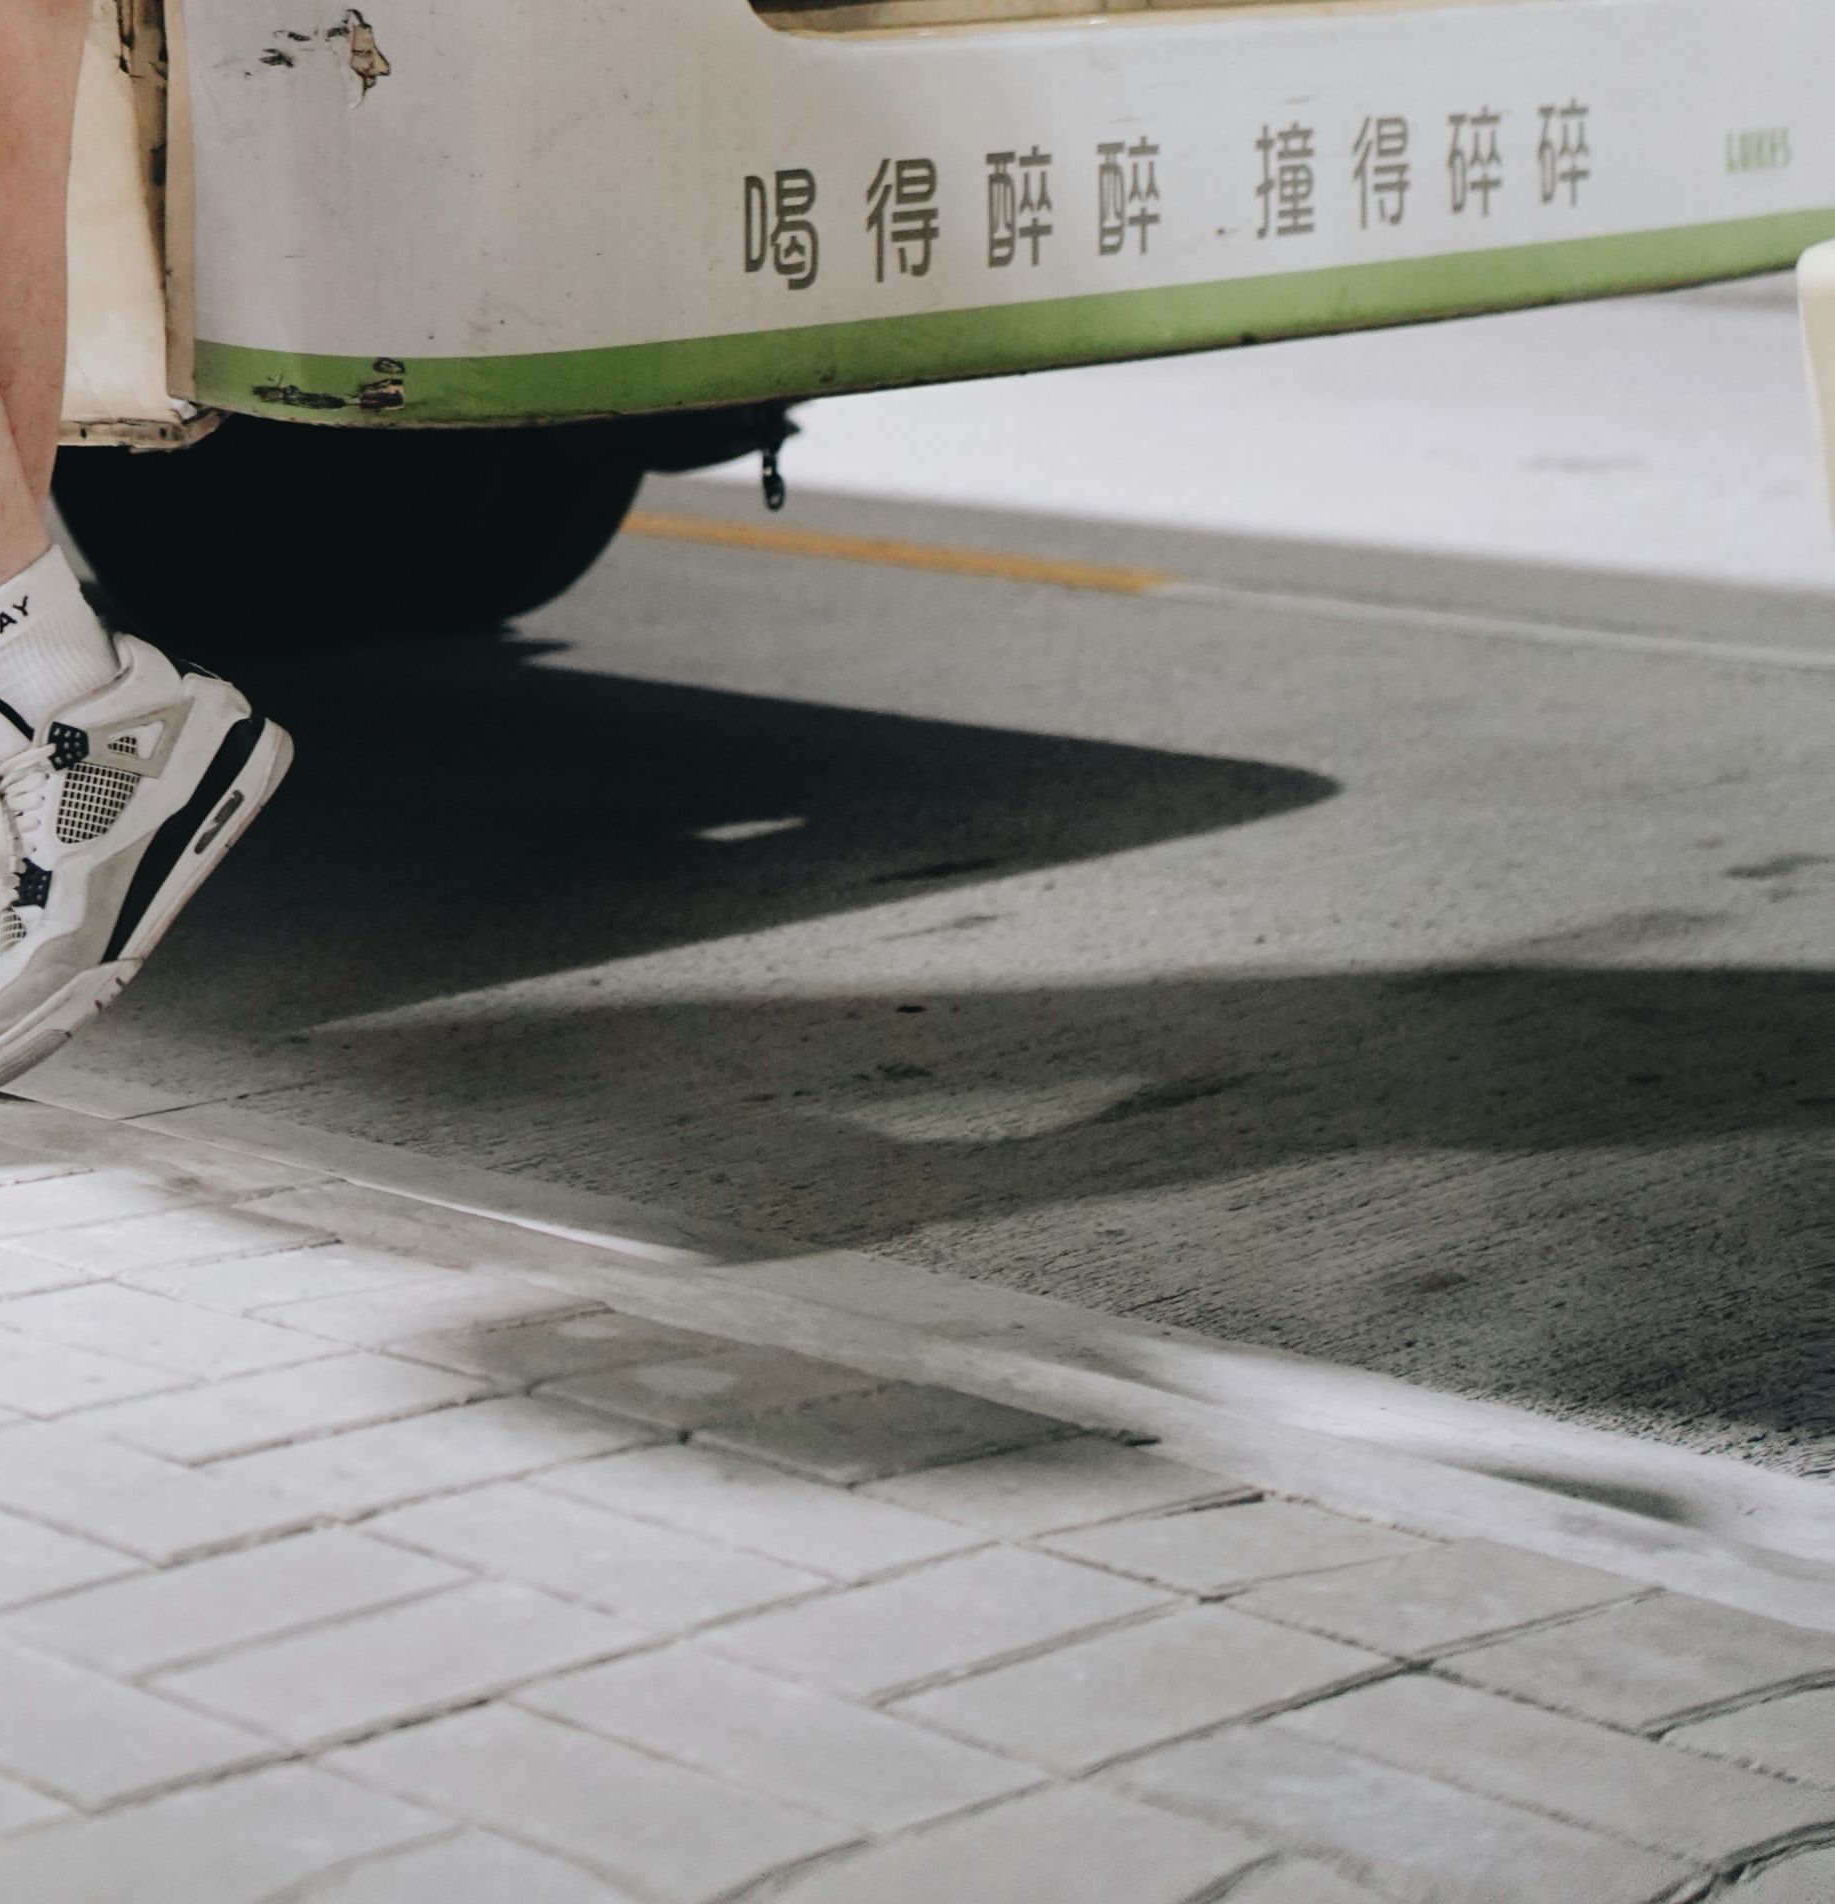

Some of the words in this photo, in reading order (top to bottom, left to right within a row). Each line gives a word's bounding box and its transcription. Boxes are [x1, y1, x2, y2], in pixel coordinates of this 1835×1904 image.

[743, 136, 1162, 291] 喝得醉醉
[1254, 97, 1590, 240] 撞得碎碎
